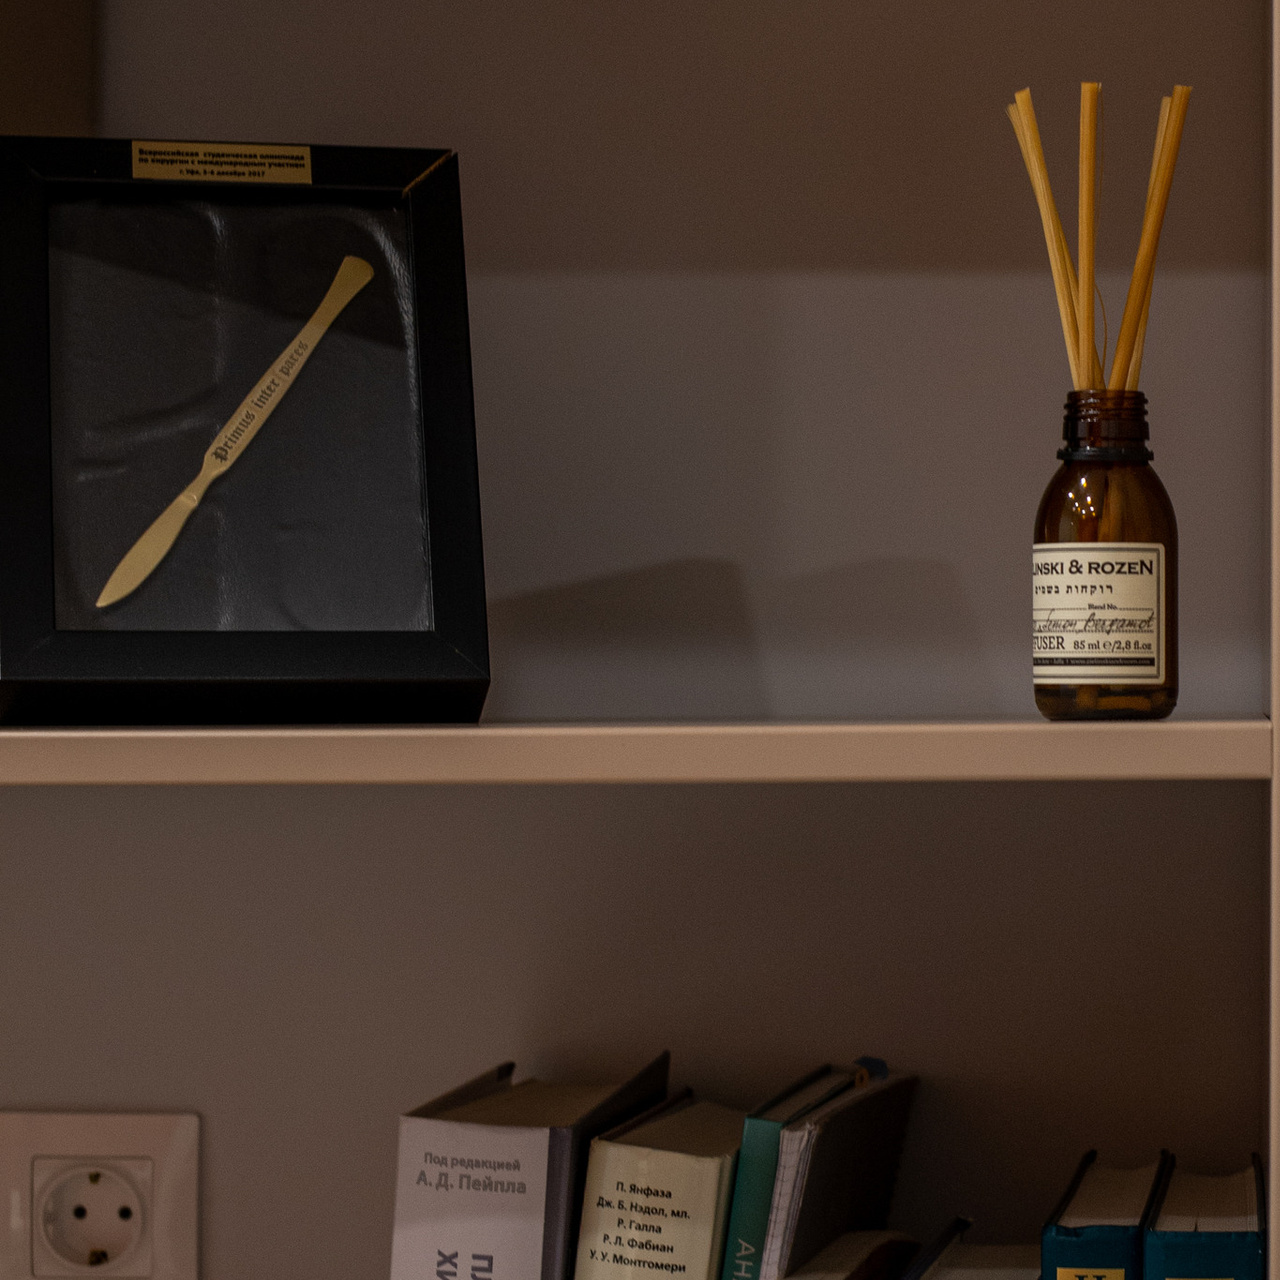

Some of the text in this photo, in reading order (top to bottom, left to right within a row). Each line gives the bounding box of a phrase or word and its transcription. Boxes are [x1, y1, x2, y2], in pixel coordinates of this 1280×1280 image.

[211, 340, 309, 463] Primus inter pares
[1069, 559, 1083, 575] &
[1088, 560, 1153, 575] ROZEN
[1073, 640, 1085, 650] 85
[1088, 640, 1100, 650] ml
[424, 1151, 521, 1172] Под редакцией
[416, 1170, 527, 1195] А. Д. Пейпла
[616, 1182, 672, 1200] П. Янфаза
[596, 1196, 691, 1219] Дж. Б. Нэдол, мл.
[617, 1218, 662, 1234] Р. Галла
[627, 1236, 674, 1254] Фабиан
[613, 1252, 686, 1274] Монтгомери
